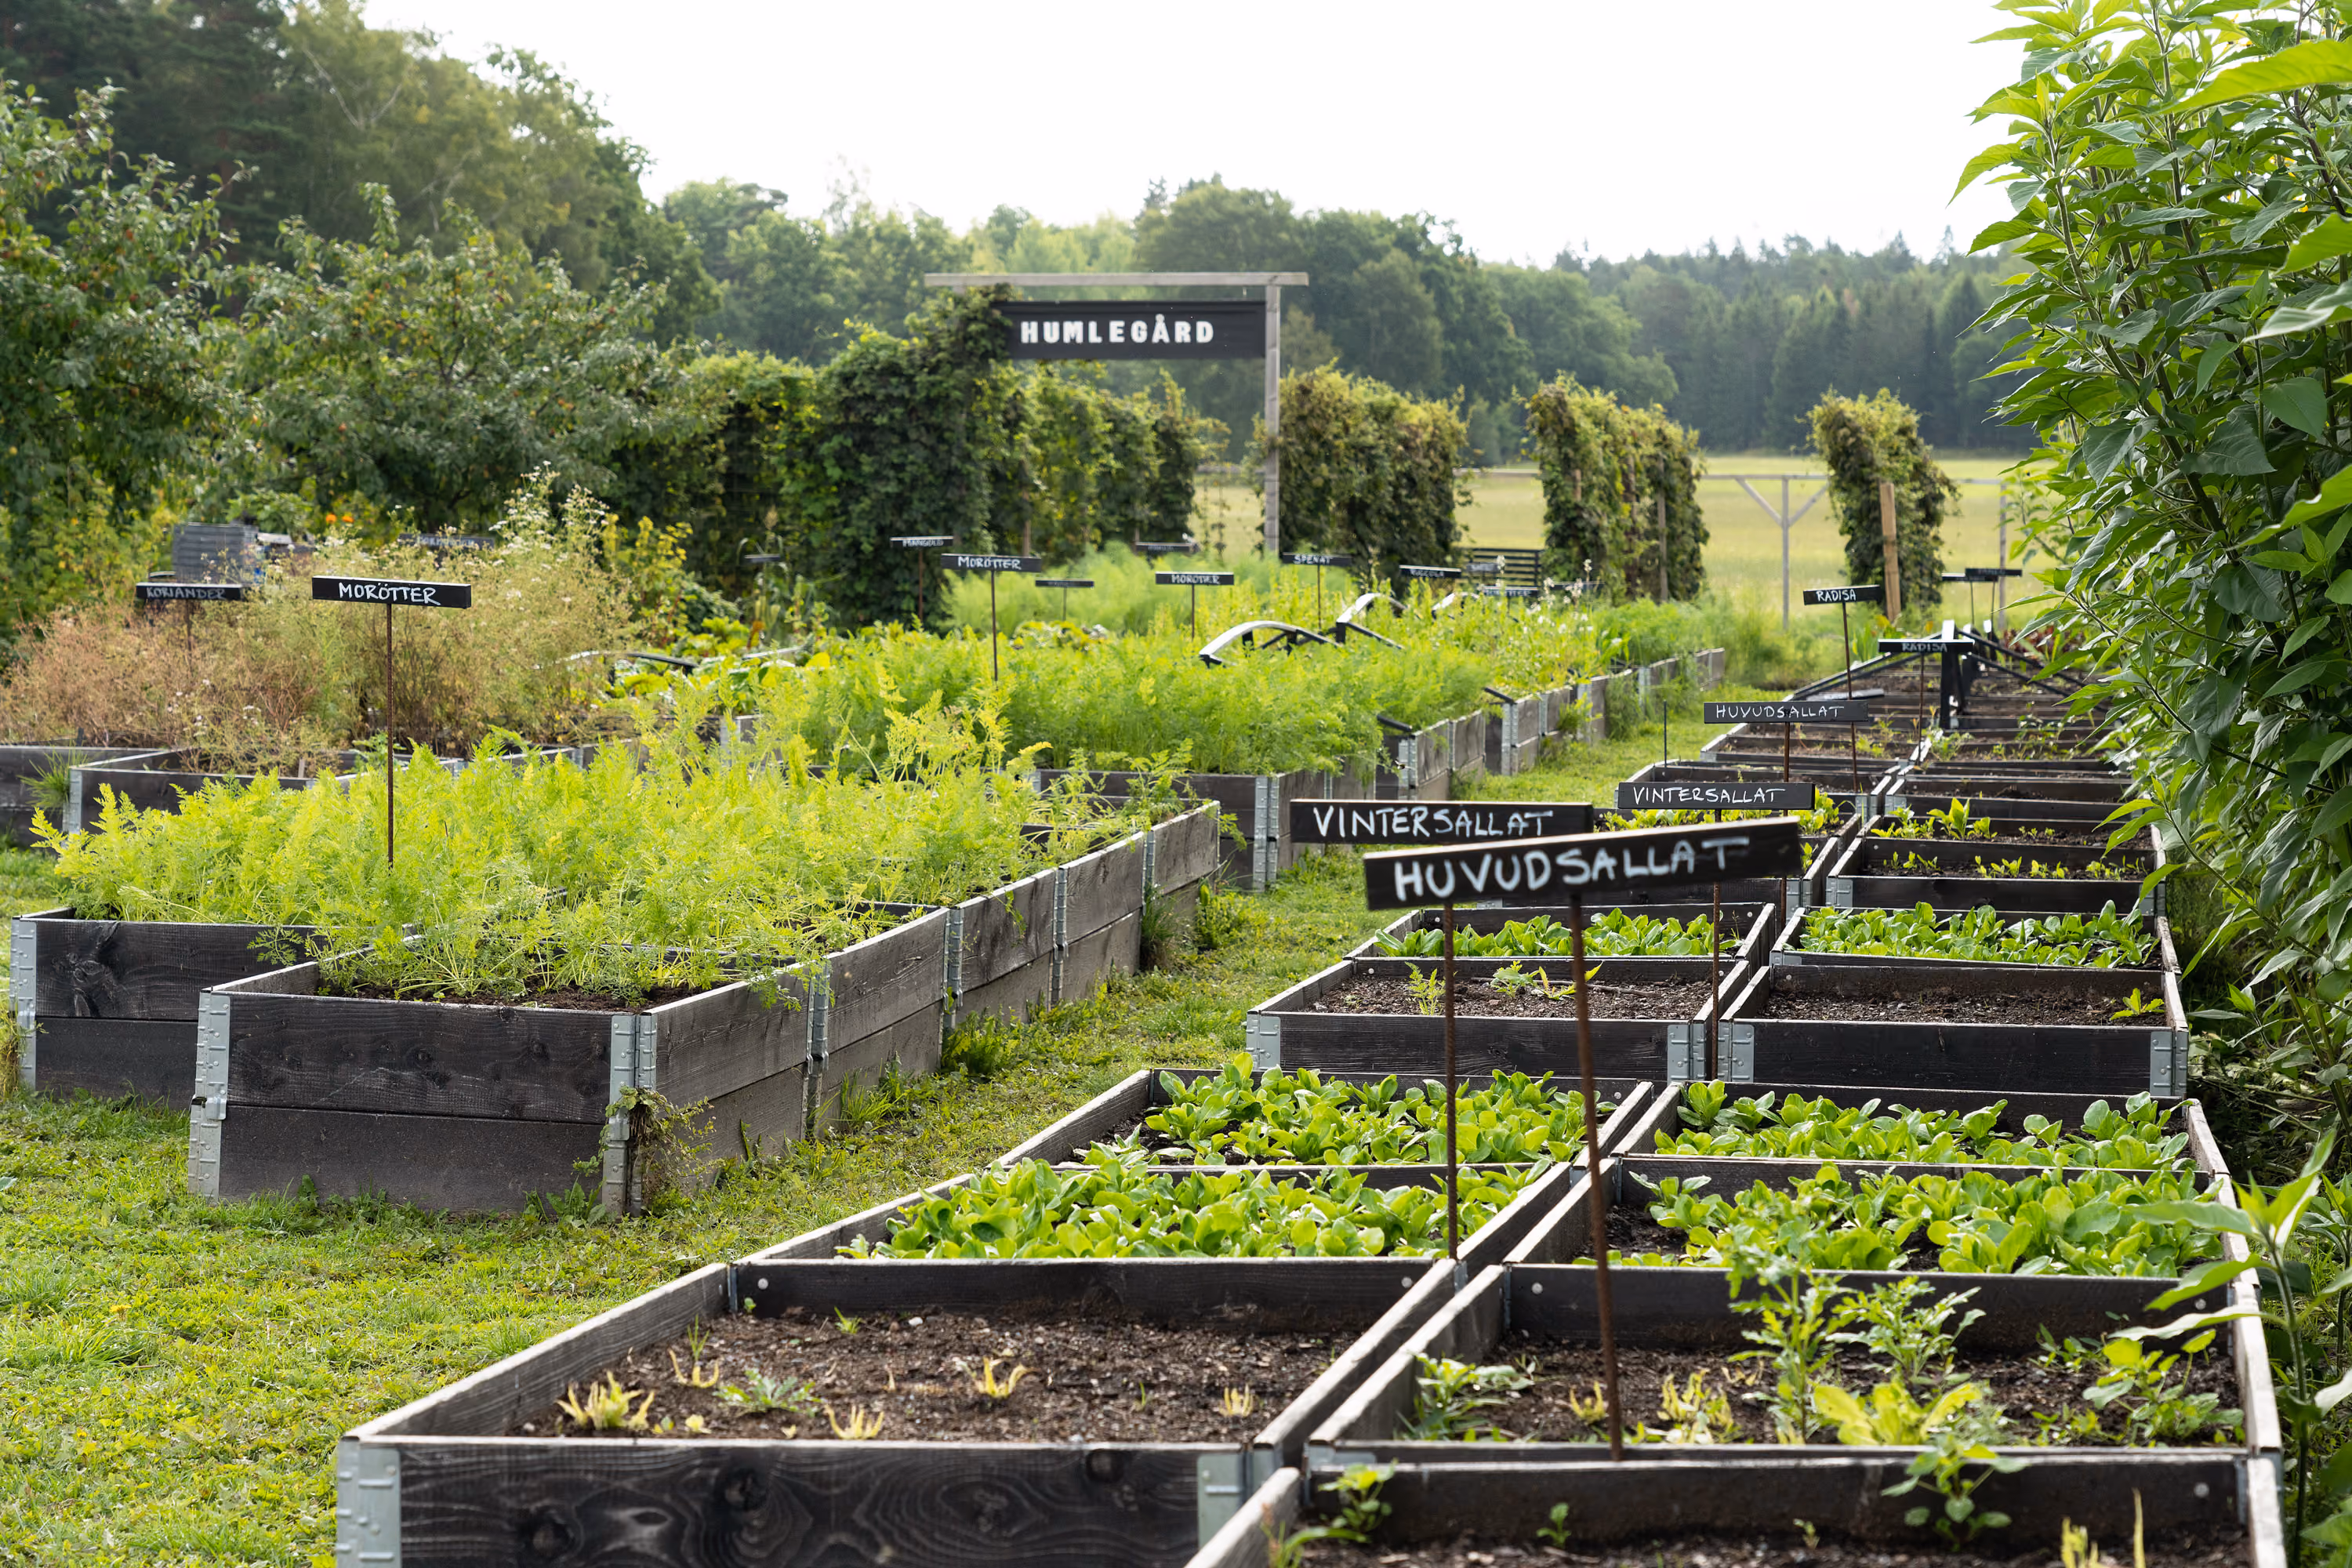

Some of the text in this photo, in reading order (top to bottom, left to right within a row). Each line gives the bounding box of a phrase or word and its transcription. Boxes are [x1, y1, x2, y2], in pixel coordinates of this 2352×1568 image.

[1021, 314, 1214, 343] HUMLEGÅRD
[1294, 554, 1331, 564] SPENAT
[146, 586, 227, 600] KORIANDER
[338, 582, 441, 606] MORÖTTER
[1715, 704, 1845, 719] HUVUDSALLAT
[1632, 786, 1787, 805] VINTERSALLAT
[1313, 805, 1554, 837] VINTERSALLAT
[1394, 836, 1750, 902] HUVUDSALLAT
